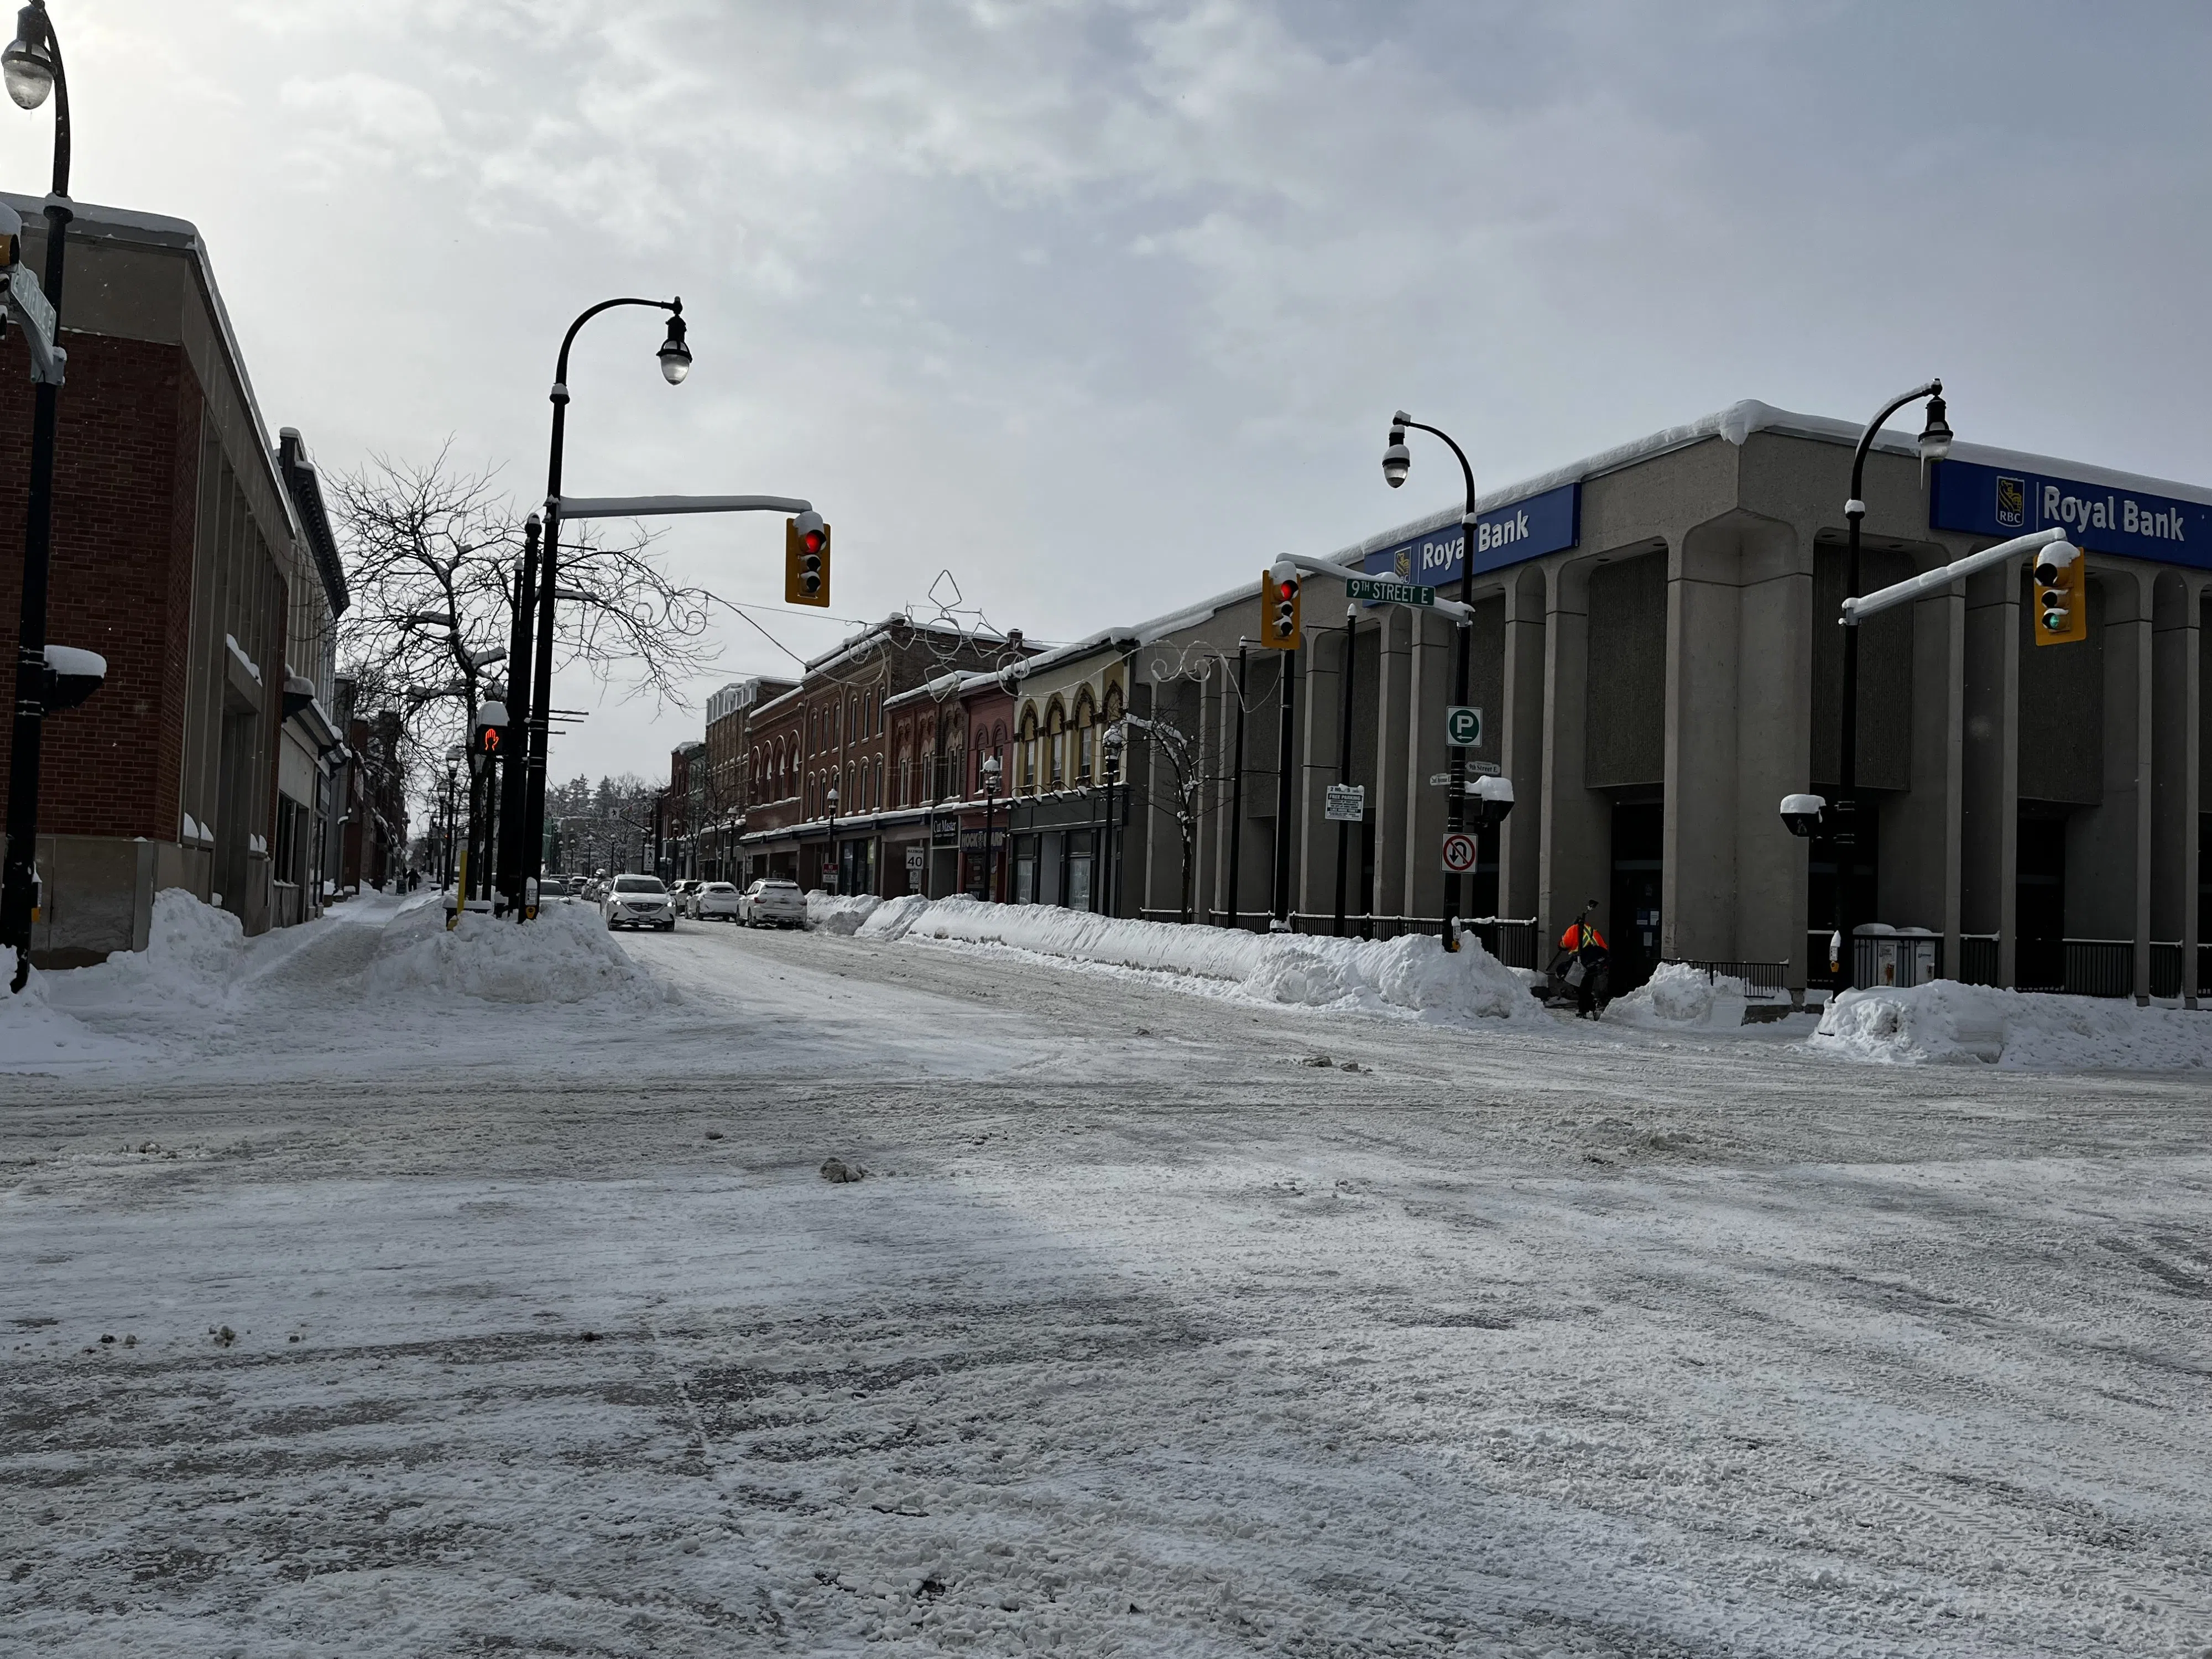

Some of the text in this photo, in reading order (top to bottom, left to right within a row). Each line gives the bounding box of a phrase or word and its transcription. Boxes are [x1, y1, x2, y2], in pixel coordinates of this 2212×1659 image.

[48, 309, 54, 337] E
[2000, 510, 2021, 523] RBC
[2044, 486, 2184, 541] Royal Bank
[1423, 510, 1529, 571] Roya Bank
[1400, 574, 1408, 584] BC
[1352, 580, 1428, 604] 9TH STREET E
[1457, 715, 1474, 733] P
[941, 820, 956, 832] Master
[962, 833, 978, 847] HOCK
[907, 857, 922, 867] 40
